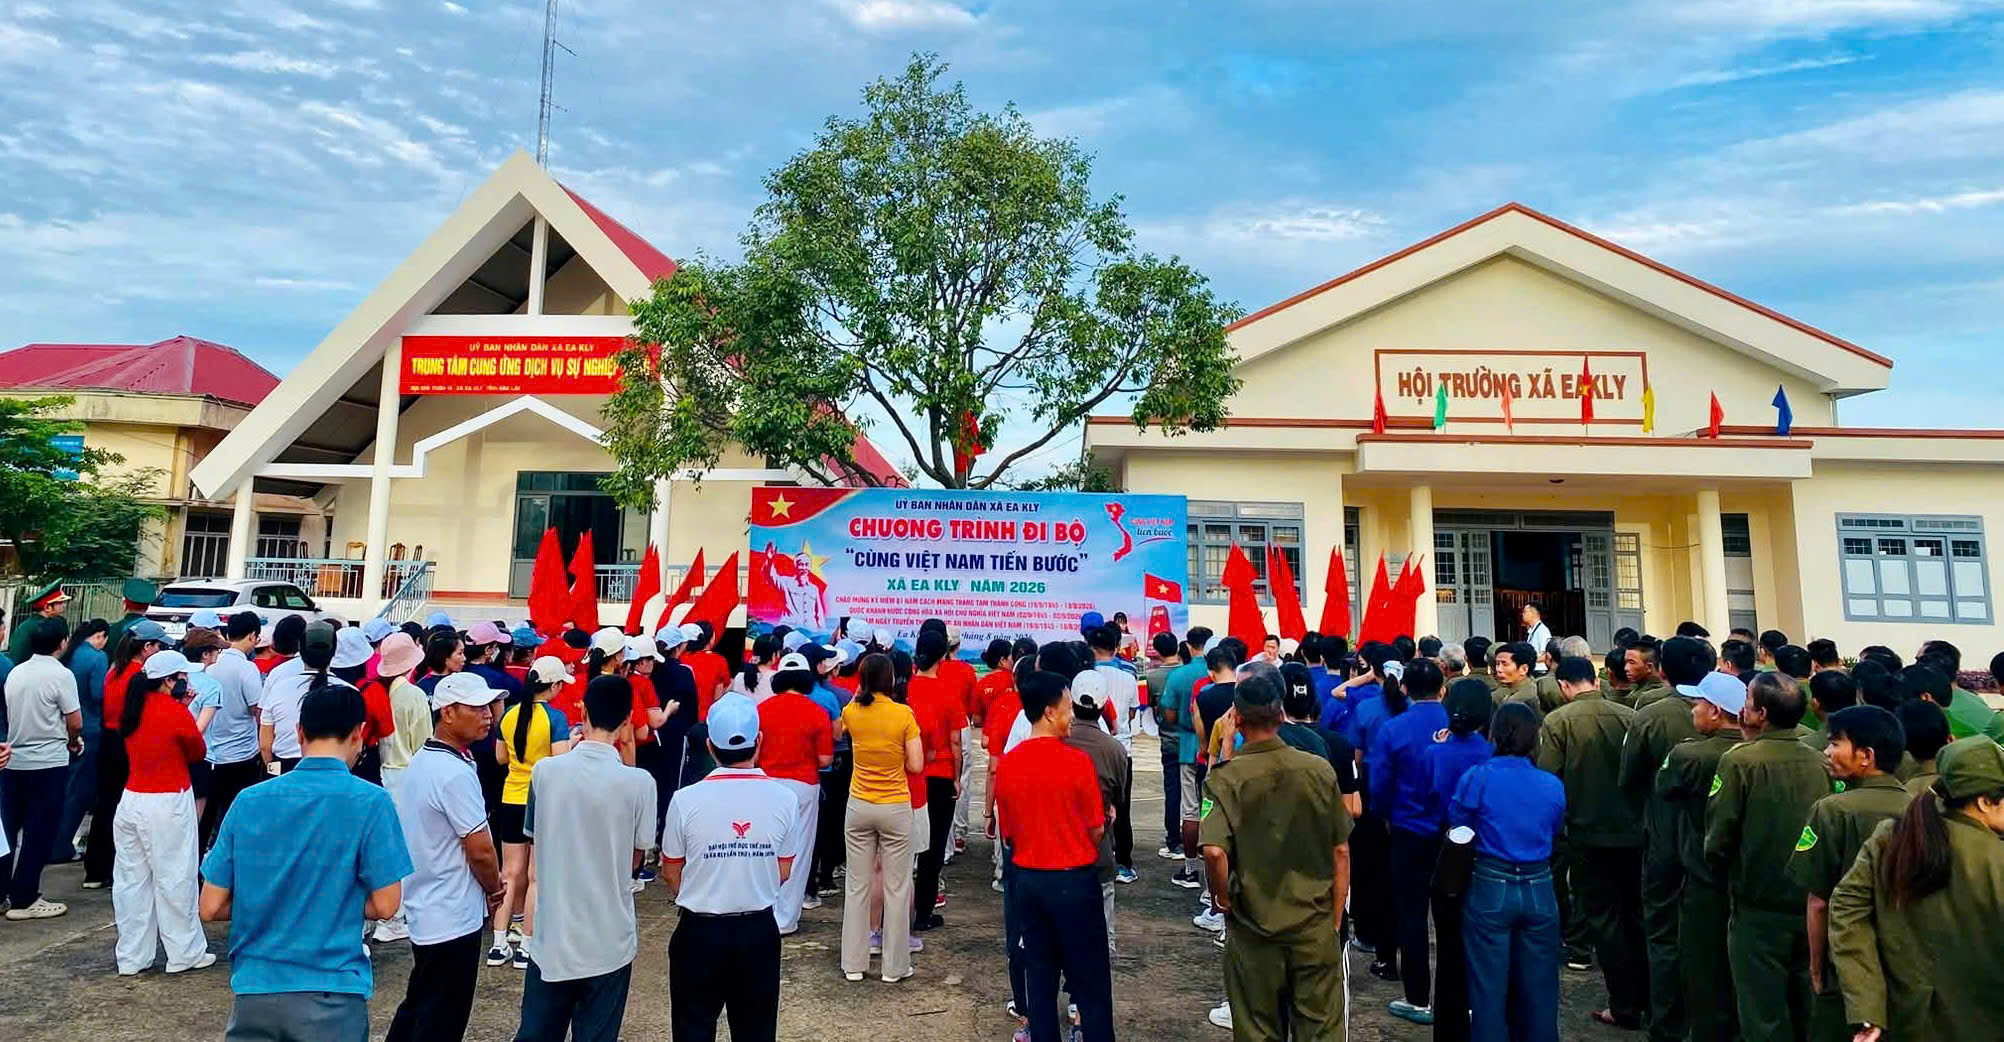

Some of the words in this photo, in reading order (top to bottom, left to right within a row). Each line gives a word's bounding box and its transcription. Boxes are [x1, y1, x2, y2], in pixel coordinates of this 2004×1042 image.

[483, 343, 501, 352] BAN
[503, 342, 527, 352] NHÂN
[530, 342, 549, 352] DÂN
[565, 343, 576, 352] EA
[578, 343, 594, 352] KLY
[411, 357, 445, 376] TRUNG
[469, 357, 497, 376] CUNG
[499, 353, 521, 376] ỨNG
[524, 357, 548, 379] DỊCH
[551, 357, 564, 379] VỤ
[566, 356, 582, 379] SỰ
[1397, 366, 1433, 405] HỘI
[1439, 365, 1522, 399] TRƯỜNG
[1527, 367, 1557, 399] XÃ
[911, 500, 932, 510] BAN
[934, 499, 963, 511] NHÂN
[965, 500, 987, 511] DÂN
[989, 500, 1003, 512] XÃ
[1006, 502, 1019, 512] EA
[1021, 503, 1040, 512] KLY
[949, 515, 1016, 541] TRÌNH
[1022, 520, 1048, 542] ĐI
[1054, 518, 1086, 548] BỘ
[905, 549, 940, 572] VIỆT
[945, 553, 984, 570] NAM
[990, 550, 1027, 571] TIẾN
[887, 576, 906, 591] XÃ
[911, 579, 929, 591] EA
[934, 579, 960, 591] KLY
[970, 580, 1005, 593] NĂM
[1009, 581, 1046, 594] 2026
[961, 631, 984, 641] háng
[986, 632, 992, 640] 8
